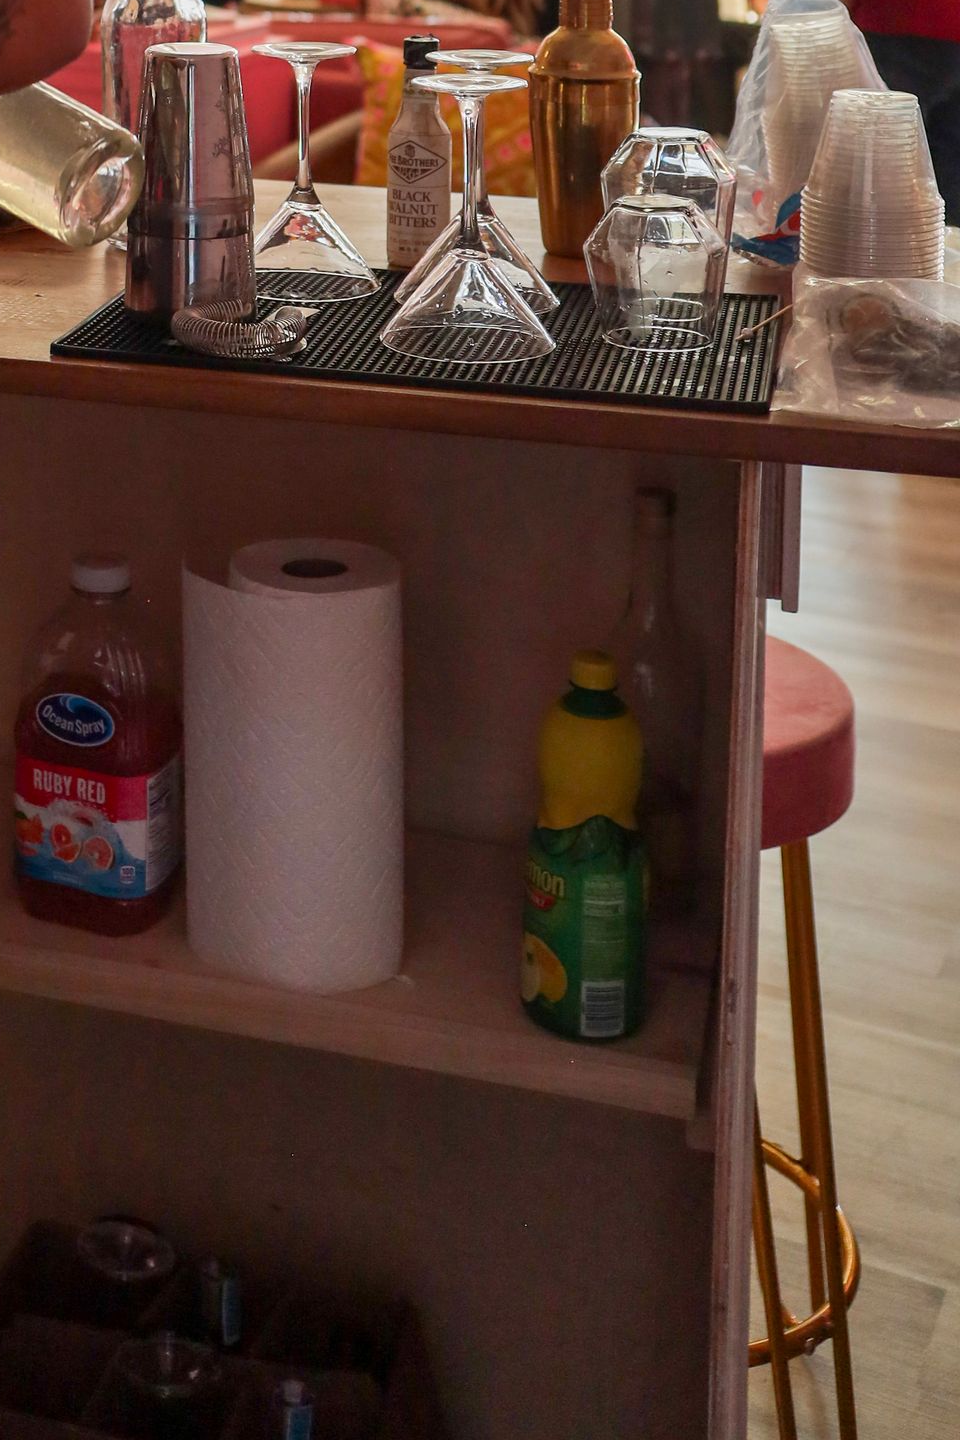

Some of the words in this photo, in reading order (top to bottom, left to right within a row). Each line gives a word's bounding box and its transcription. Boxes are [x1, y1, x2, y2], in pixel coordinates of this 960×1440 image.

[398, 155, 439, 168] BROTHERS
[392, 188, 432, 203] BLACK
[389, 214, 437, 229] BITTERS
[33, 768, 73, 796] RUBY
[76, 778, 106, 804] RED
